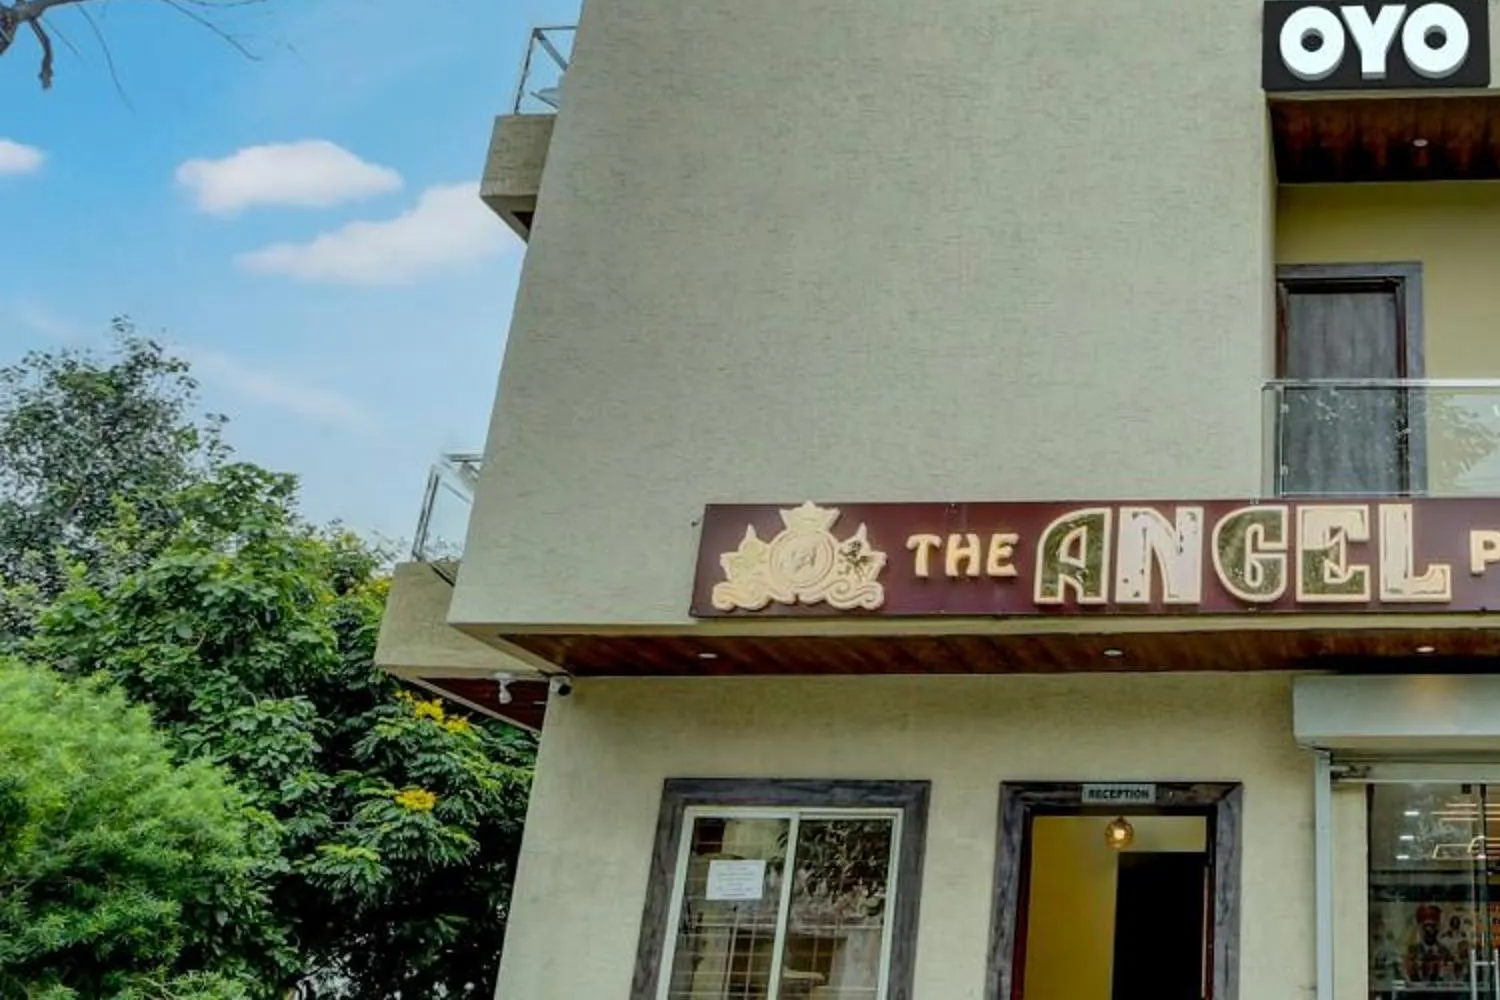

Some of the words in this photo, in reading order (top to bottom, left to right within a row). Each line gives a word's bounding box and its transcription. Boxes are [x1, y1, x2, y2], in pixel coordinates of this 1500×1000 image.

[1280, 2, 1469, 81] OYO
[907, 533, 1019, 577] THE
[1034, 503, 1451, 603] ANGEL
[1088, 788, 1150, 800] RECEPTION
